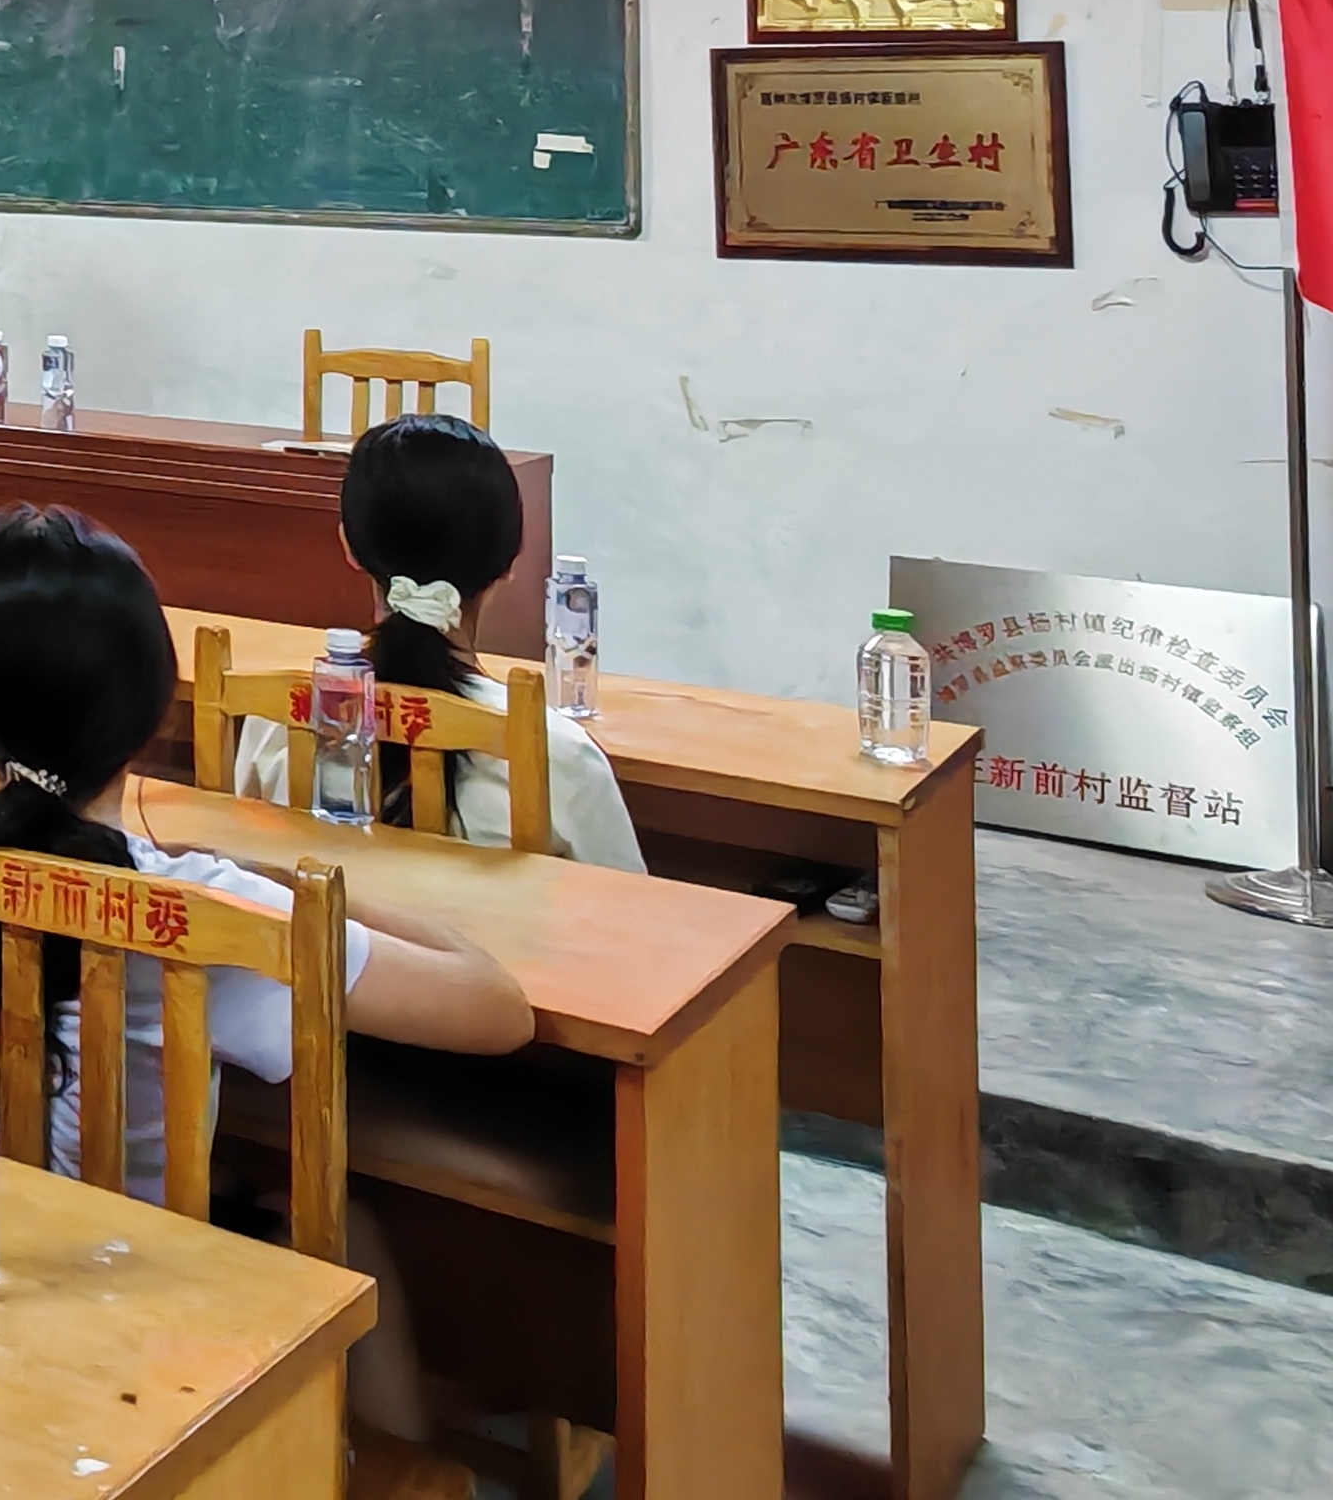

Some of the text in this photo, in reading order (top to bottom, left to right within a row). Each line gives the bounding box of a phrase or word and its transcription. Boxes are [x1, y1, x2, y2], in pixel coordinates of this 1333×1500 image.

[765, 130, 1006, 174] 广东省卫生村
[0, 859, 189, 953] 新前村委
